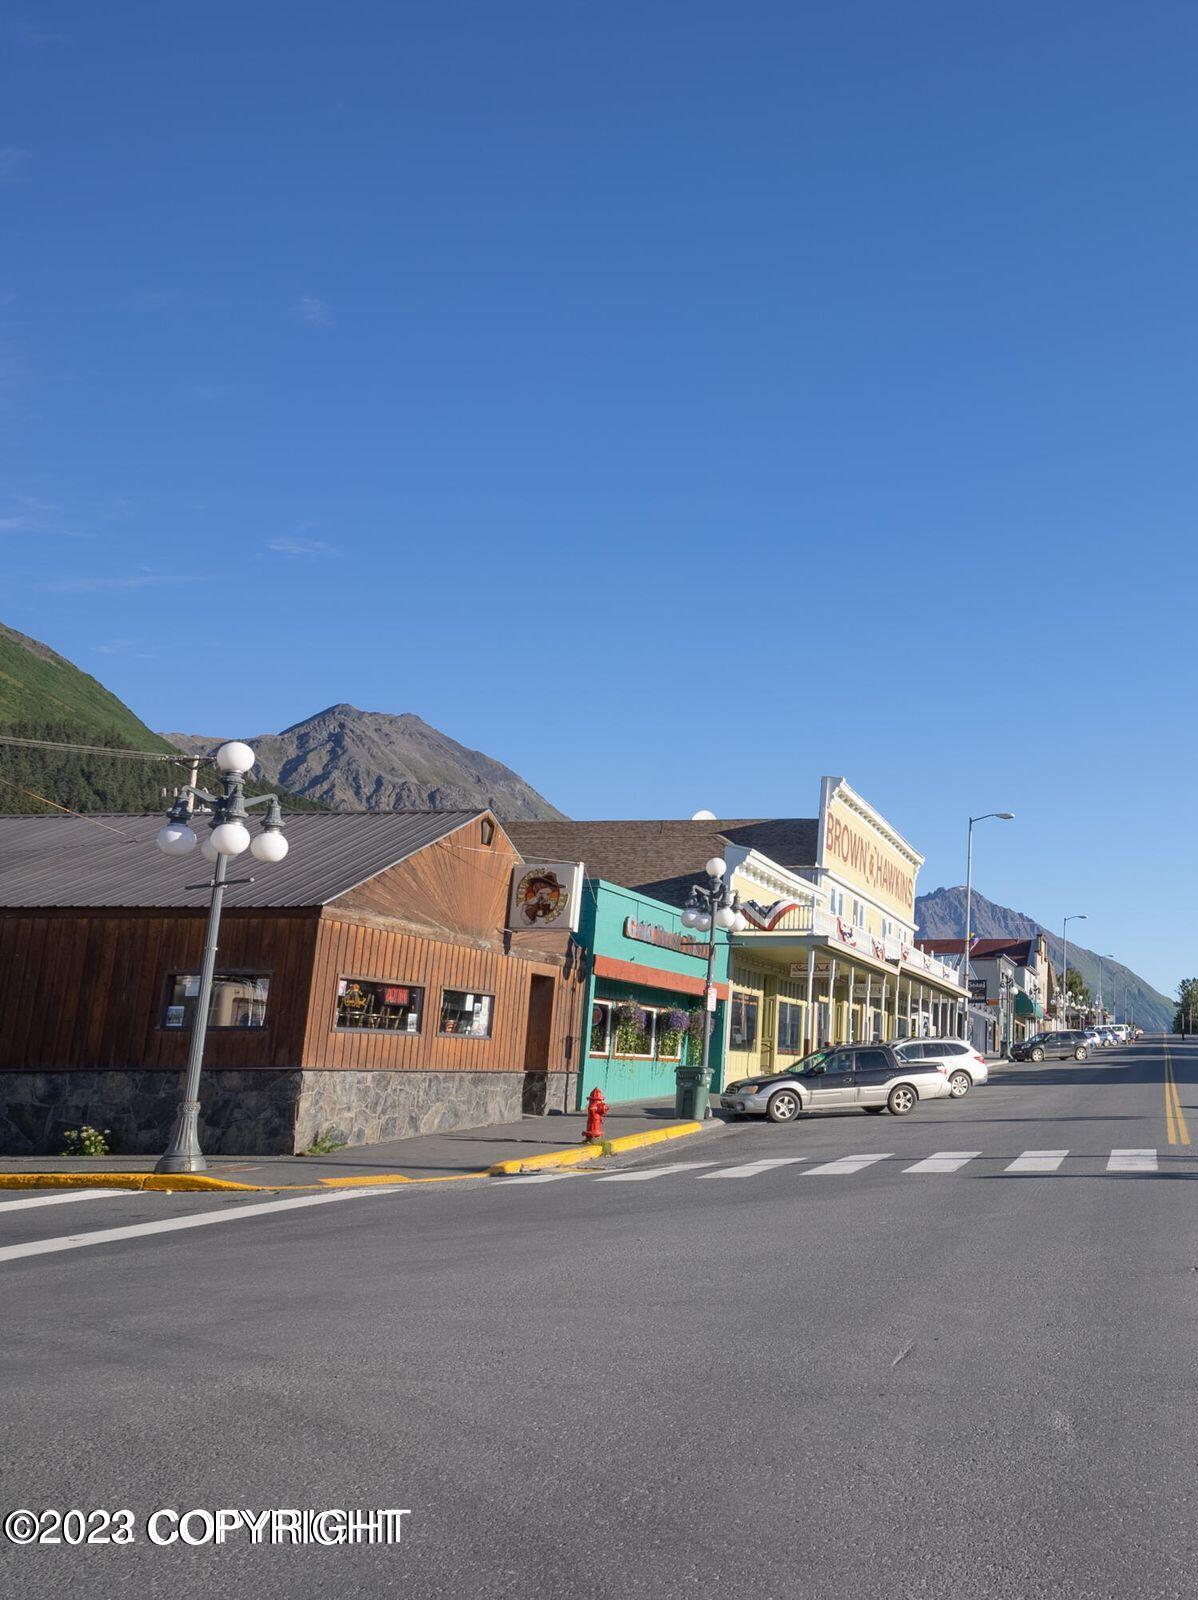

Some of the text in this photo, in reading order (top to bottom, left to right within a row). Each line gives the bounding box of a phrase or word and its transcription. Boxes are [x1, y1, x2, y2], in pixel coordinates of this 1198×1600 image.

[826, 811, 870, 875] BROWN
[876, 850, 913, 909] HAWKINS
[386, 988, 408, 1004] ATM
